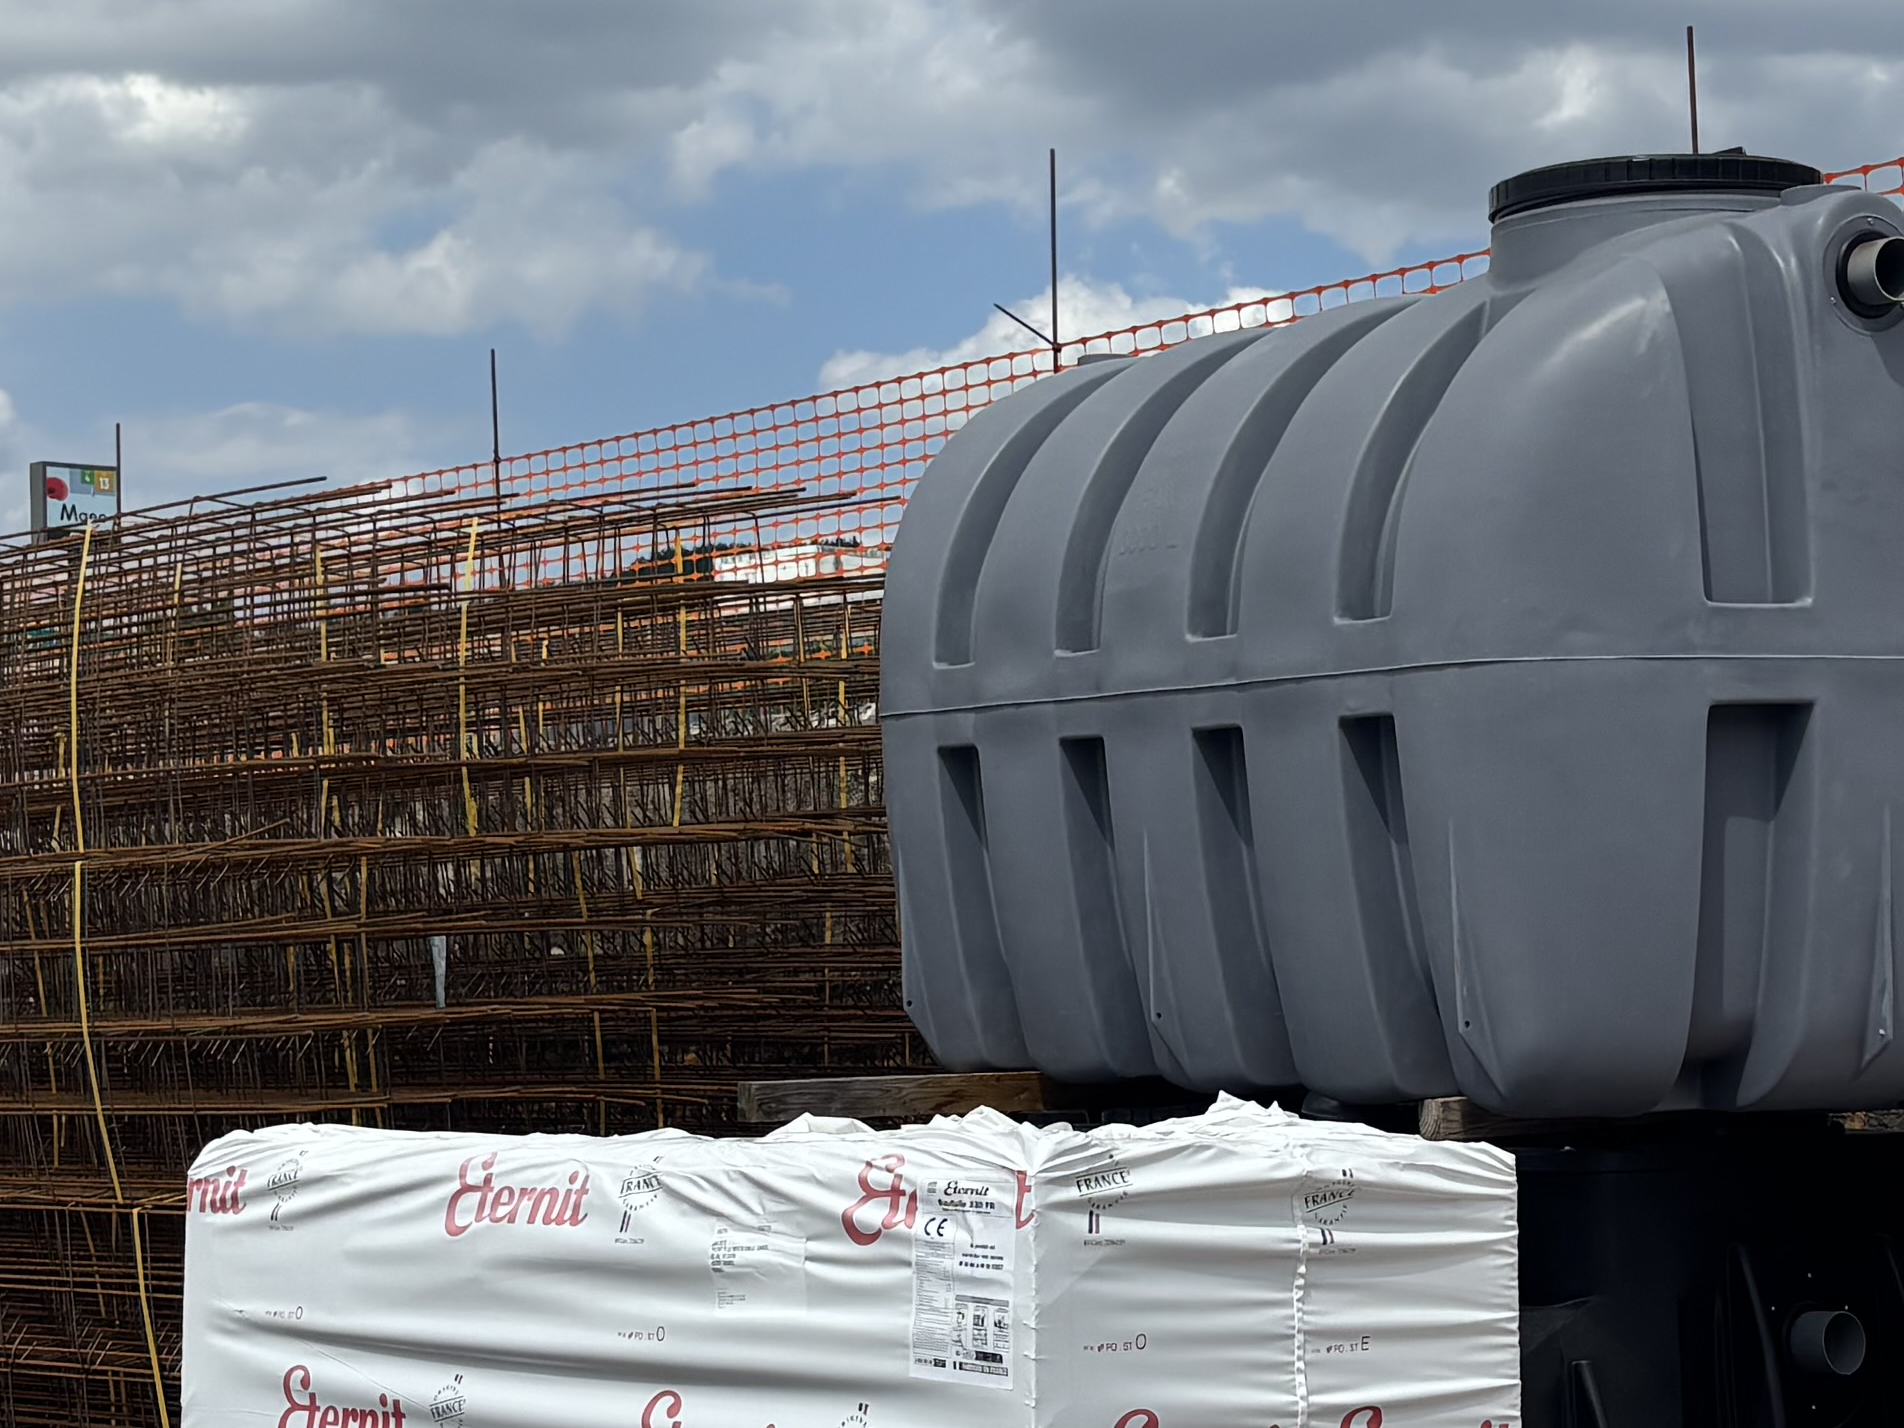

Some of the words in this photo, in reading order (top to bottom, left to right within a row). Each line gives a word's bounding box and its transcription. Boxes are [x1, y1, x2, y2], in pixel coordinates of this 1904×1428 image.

[1075, 1171, 1130, 1193] FRANCE
[445, 1152, 589, 1237] Eternit
[430, 1398, 465, 1419] FRANCE
